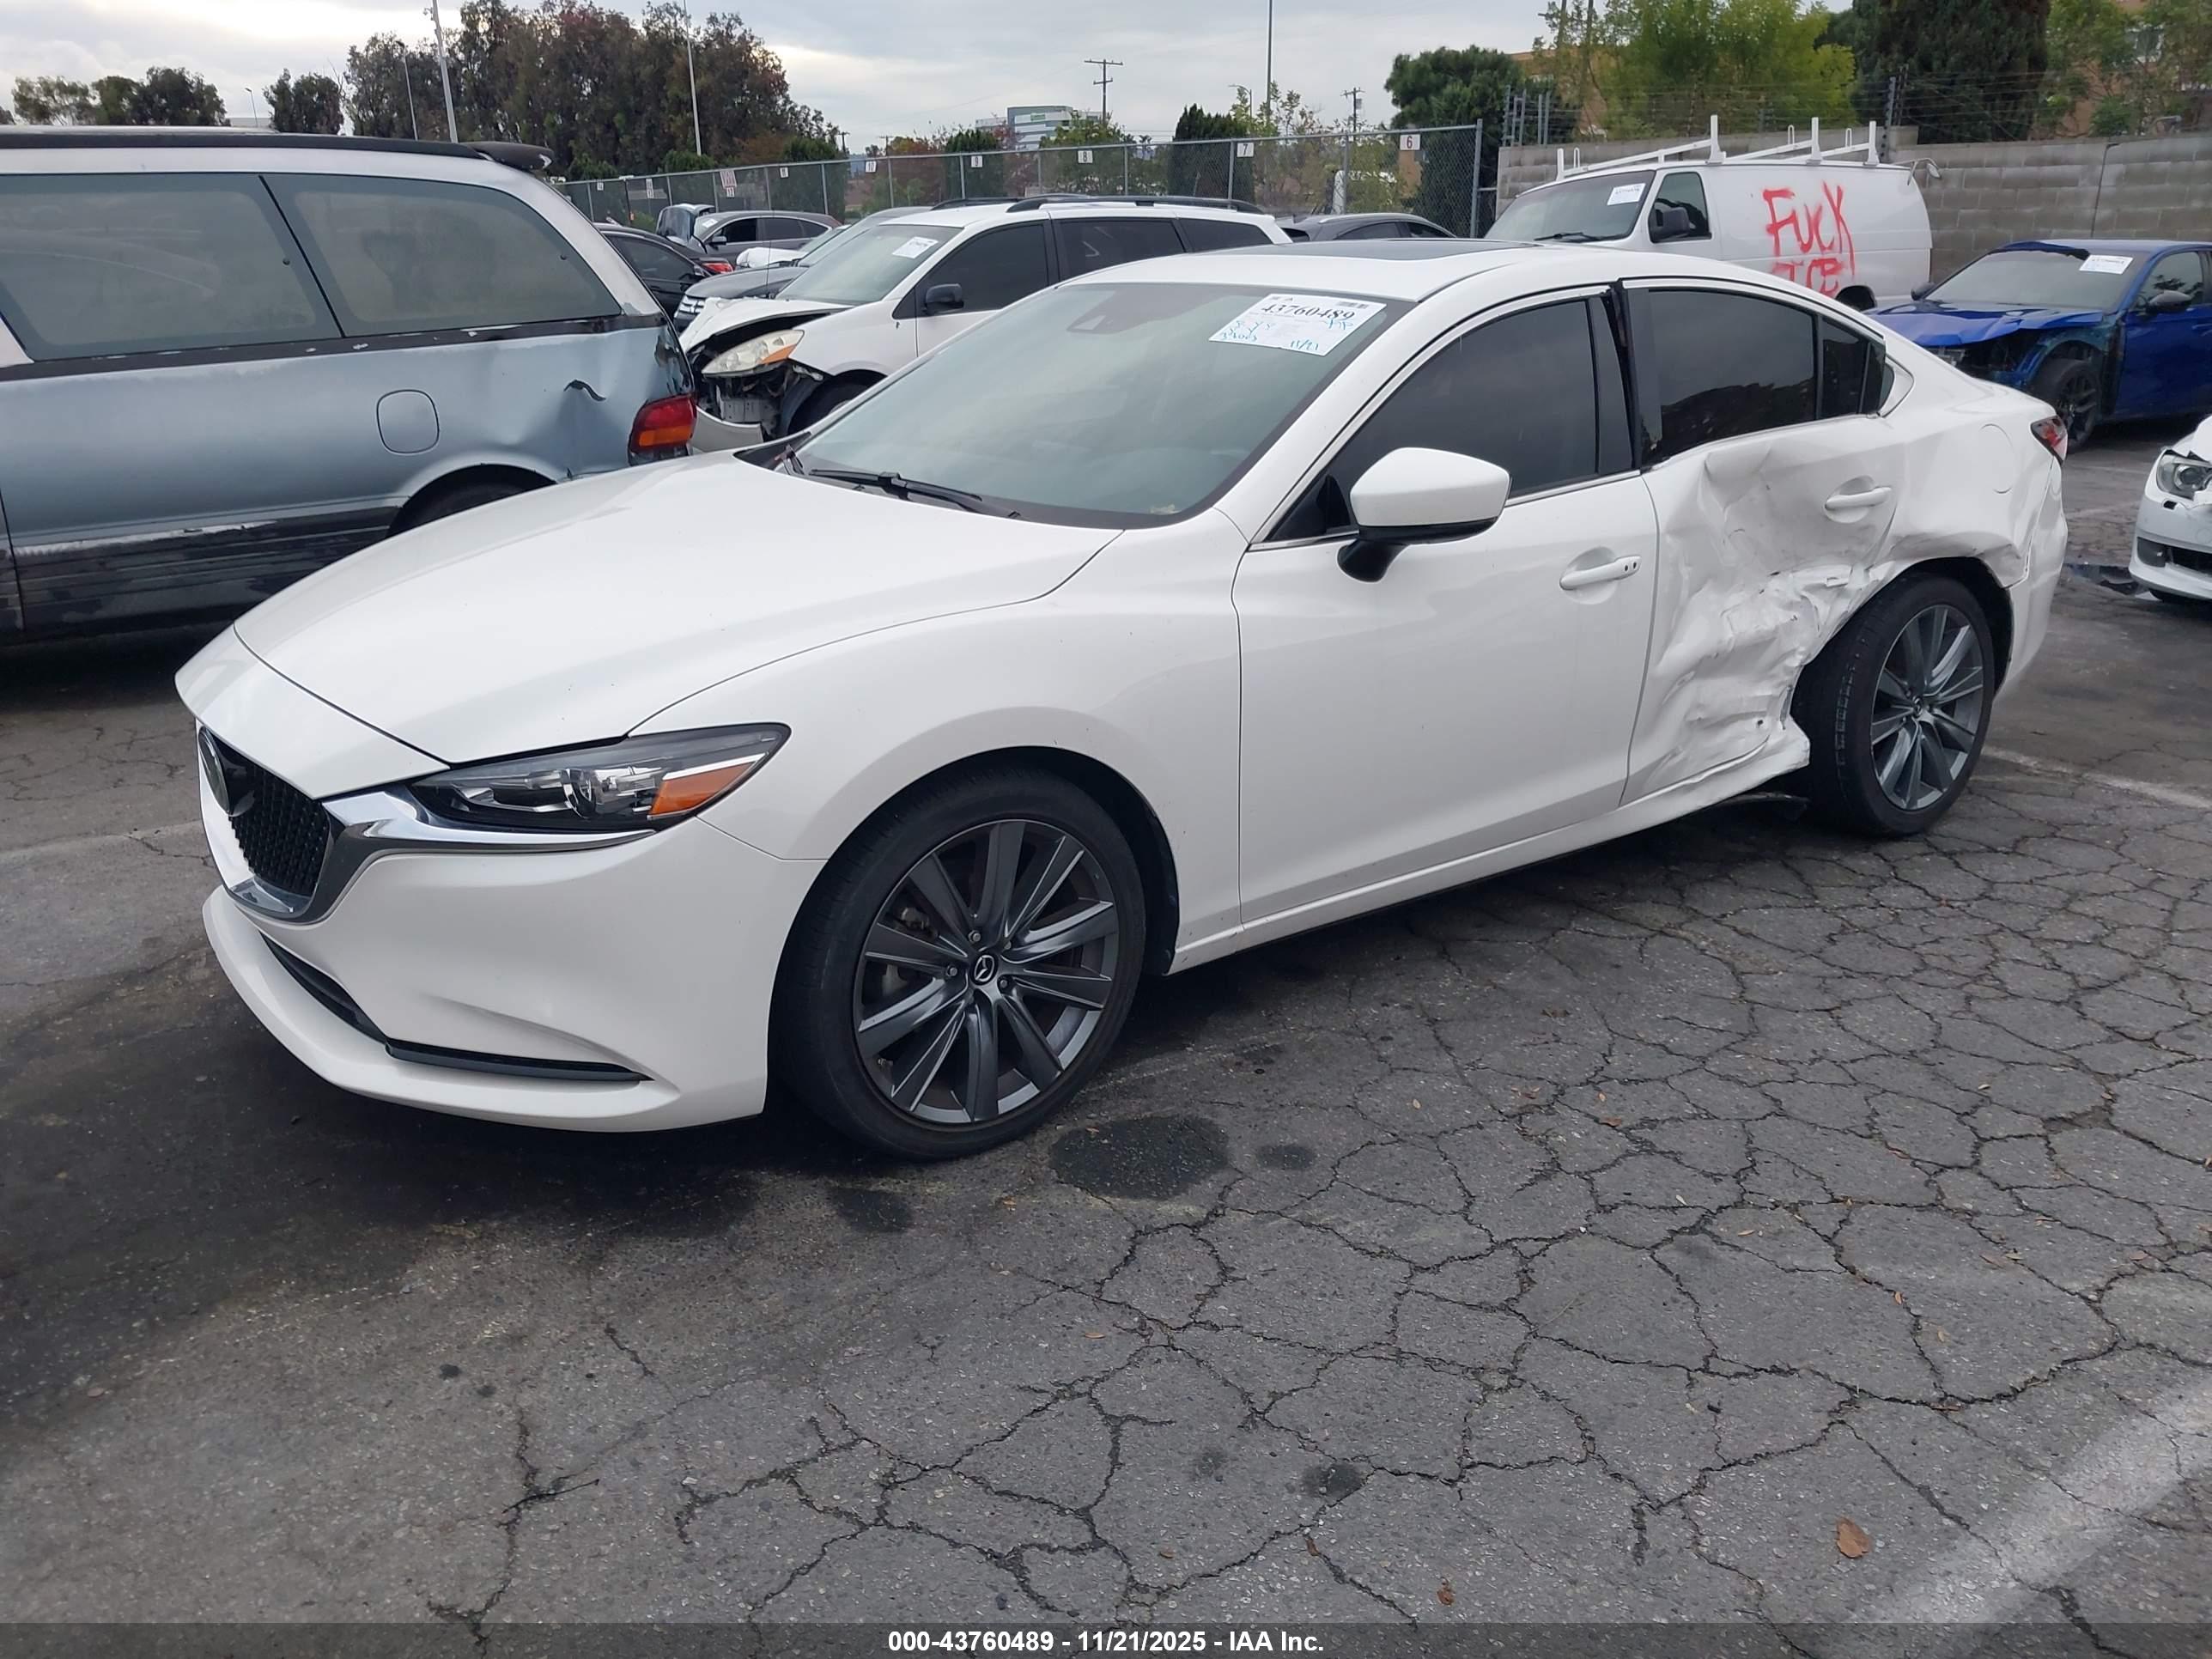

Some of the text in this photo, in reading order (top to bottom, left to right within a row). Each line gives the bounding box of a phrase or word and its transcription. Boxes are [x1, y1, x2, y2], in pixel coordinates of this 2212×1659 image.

[1243, 143, 1249, 155] 7
[1407, 136, 1413, 149] 6
[1083, 151, 1088, 162] 8
[1762, 180, 1856, 278] FUCK
[1261, 304, 1356, 321] 43760489
